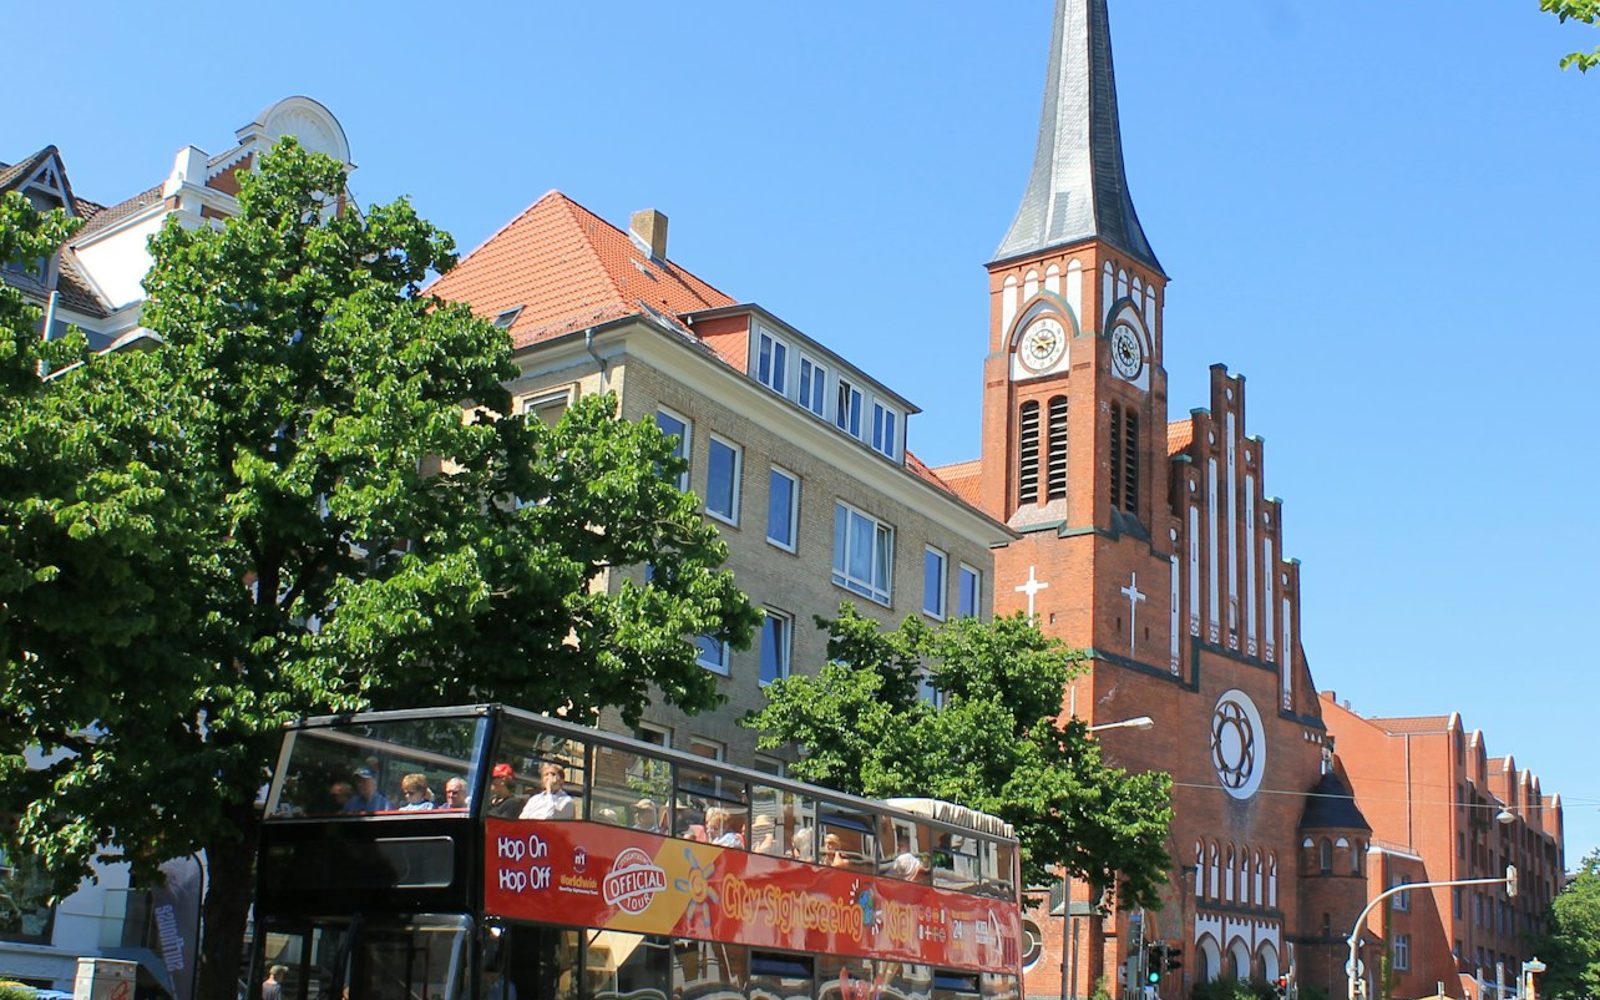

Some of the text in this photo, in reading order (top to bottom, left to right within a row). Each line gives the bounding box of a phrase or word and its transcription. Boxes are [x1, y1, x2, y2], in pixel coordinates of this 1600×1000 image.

[498, 835, 547, 862] Hop On
[499, 865, 551, 892] Hop Off
[610, 872, 663, 897] OFFICIAL
[627, 893, 651, 910] TOUR
[722, 873, 760, 924] City
[763, 884, 863, 943] Sightseeing
[952, 920, 962, 938] 24
